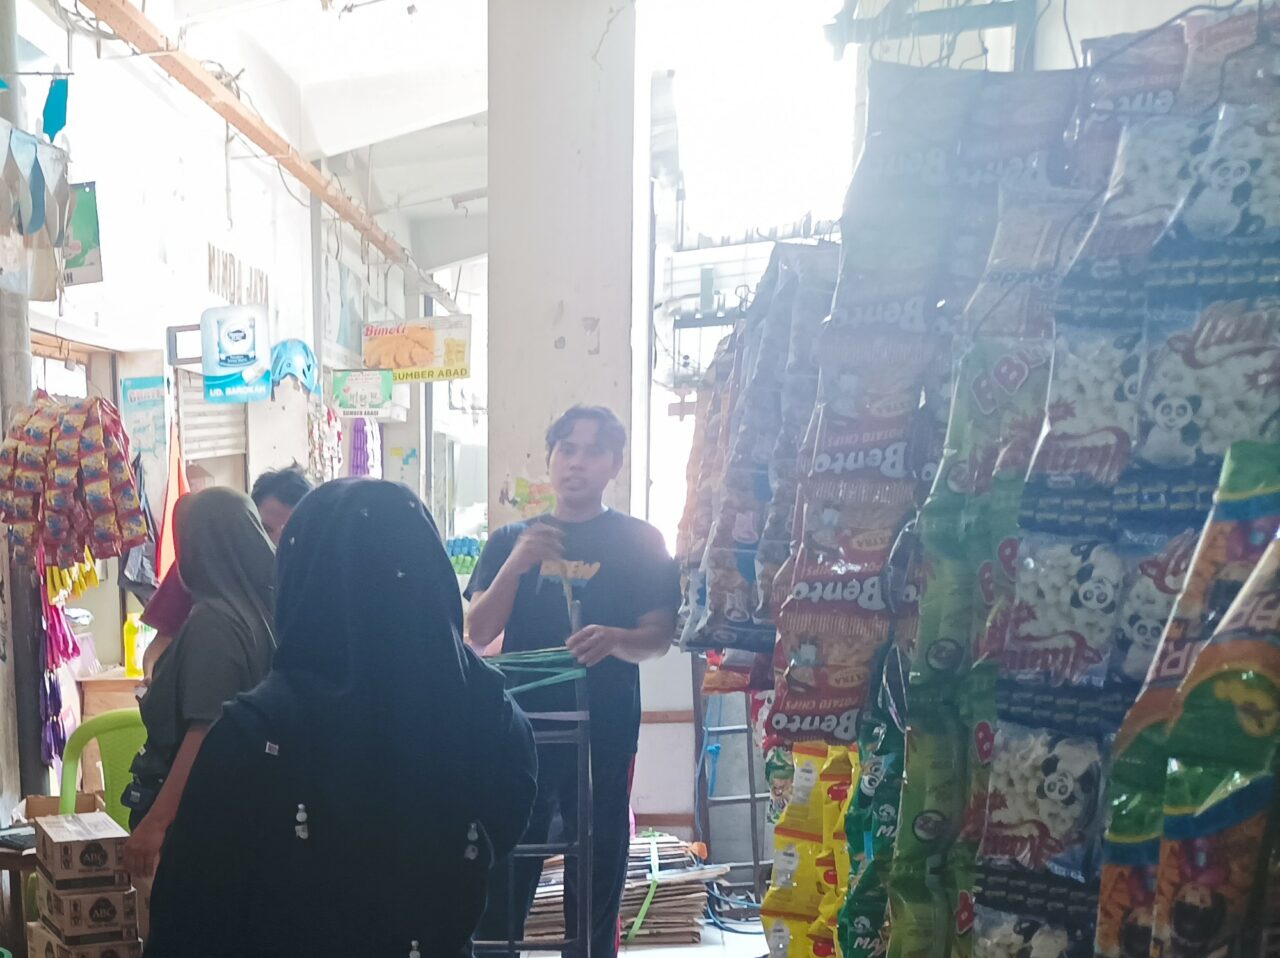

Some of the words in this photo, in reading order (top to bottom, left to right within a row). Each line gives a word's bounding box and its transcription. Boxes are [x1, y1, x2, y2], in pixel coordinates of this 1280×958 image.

[363, 323, 408, 337] Bimoli
[392, 370, 435, 381] SUMBER
[815, 441, 909, 479] Bento
[793, 576, 888, 612] Bento
[771, 708, 862, 742] Bento
[91, 908, 112, 918] ABC
